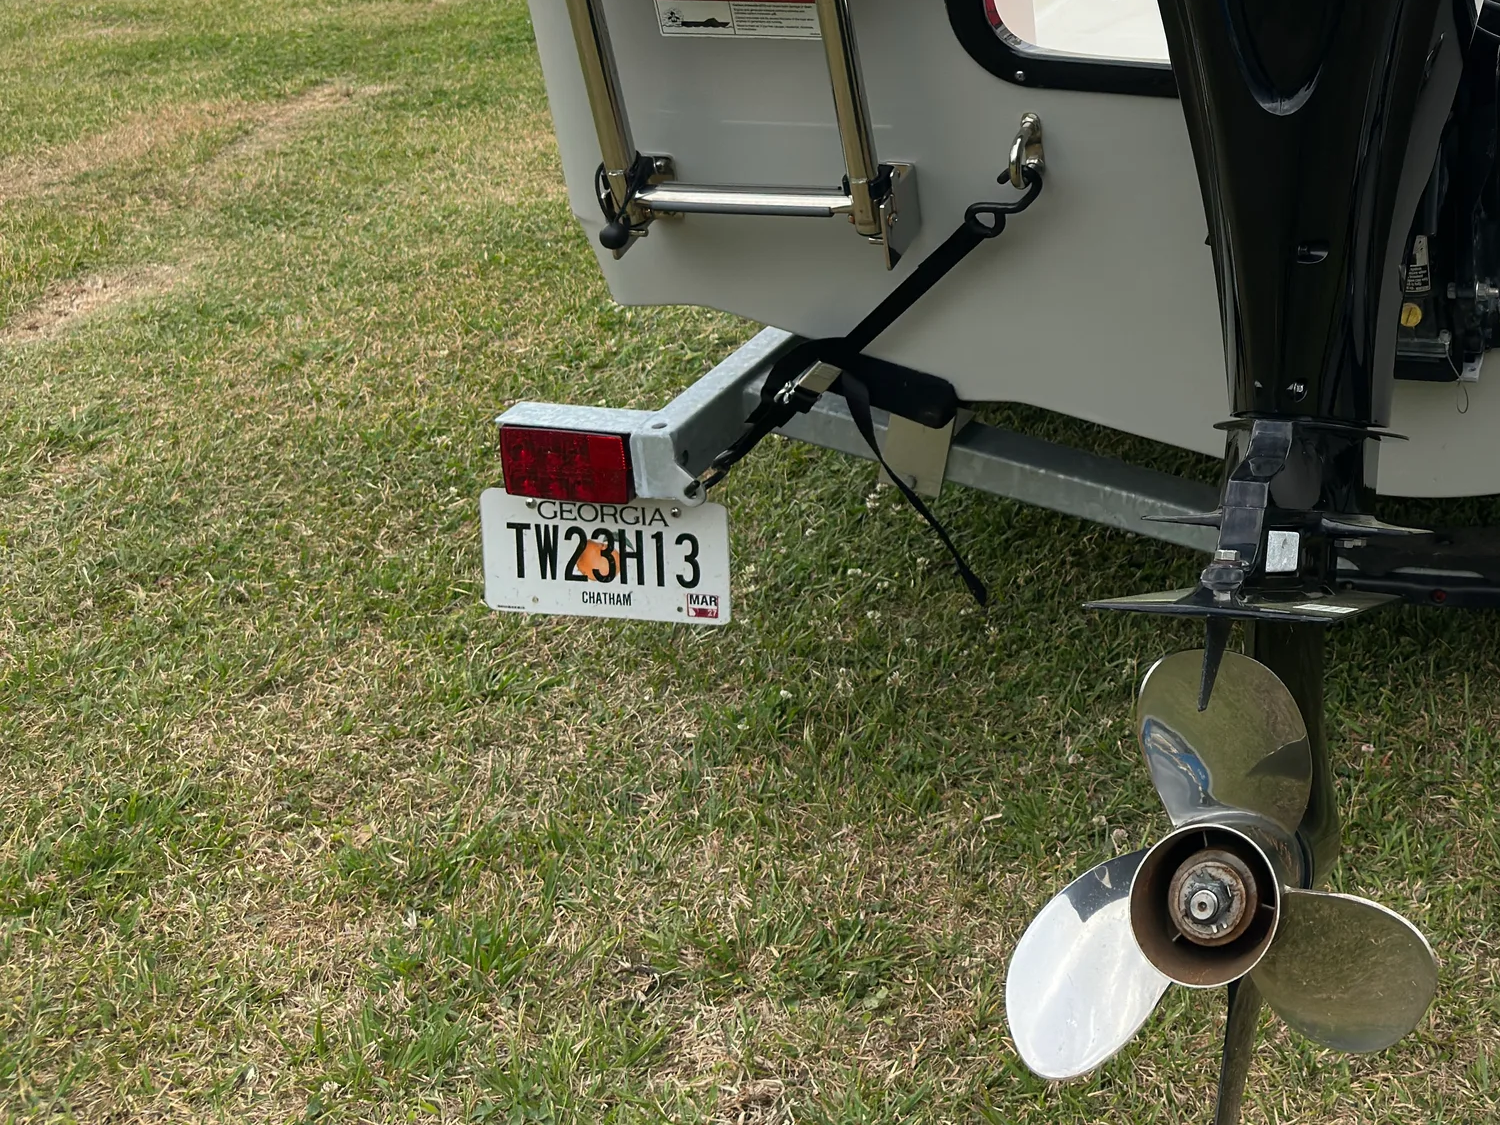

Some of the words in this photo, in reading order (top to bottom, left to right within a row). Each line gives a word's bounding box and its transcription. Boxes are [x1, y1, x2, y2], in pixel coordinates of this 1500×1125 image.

[537, 500, 669, 527] GEORGIA
[506, 522, 701, 589] TW23H13
[581, 590, 632, 607] CHATHAM
[689, 594, 718, 606] MAR
